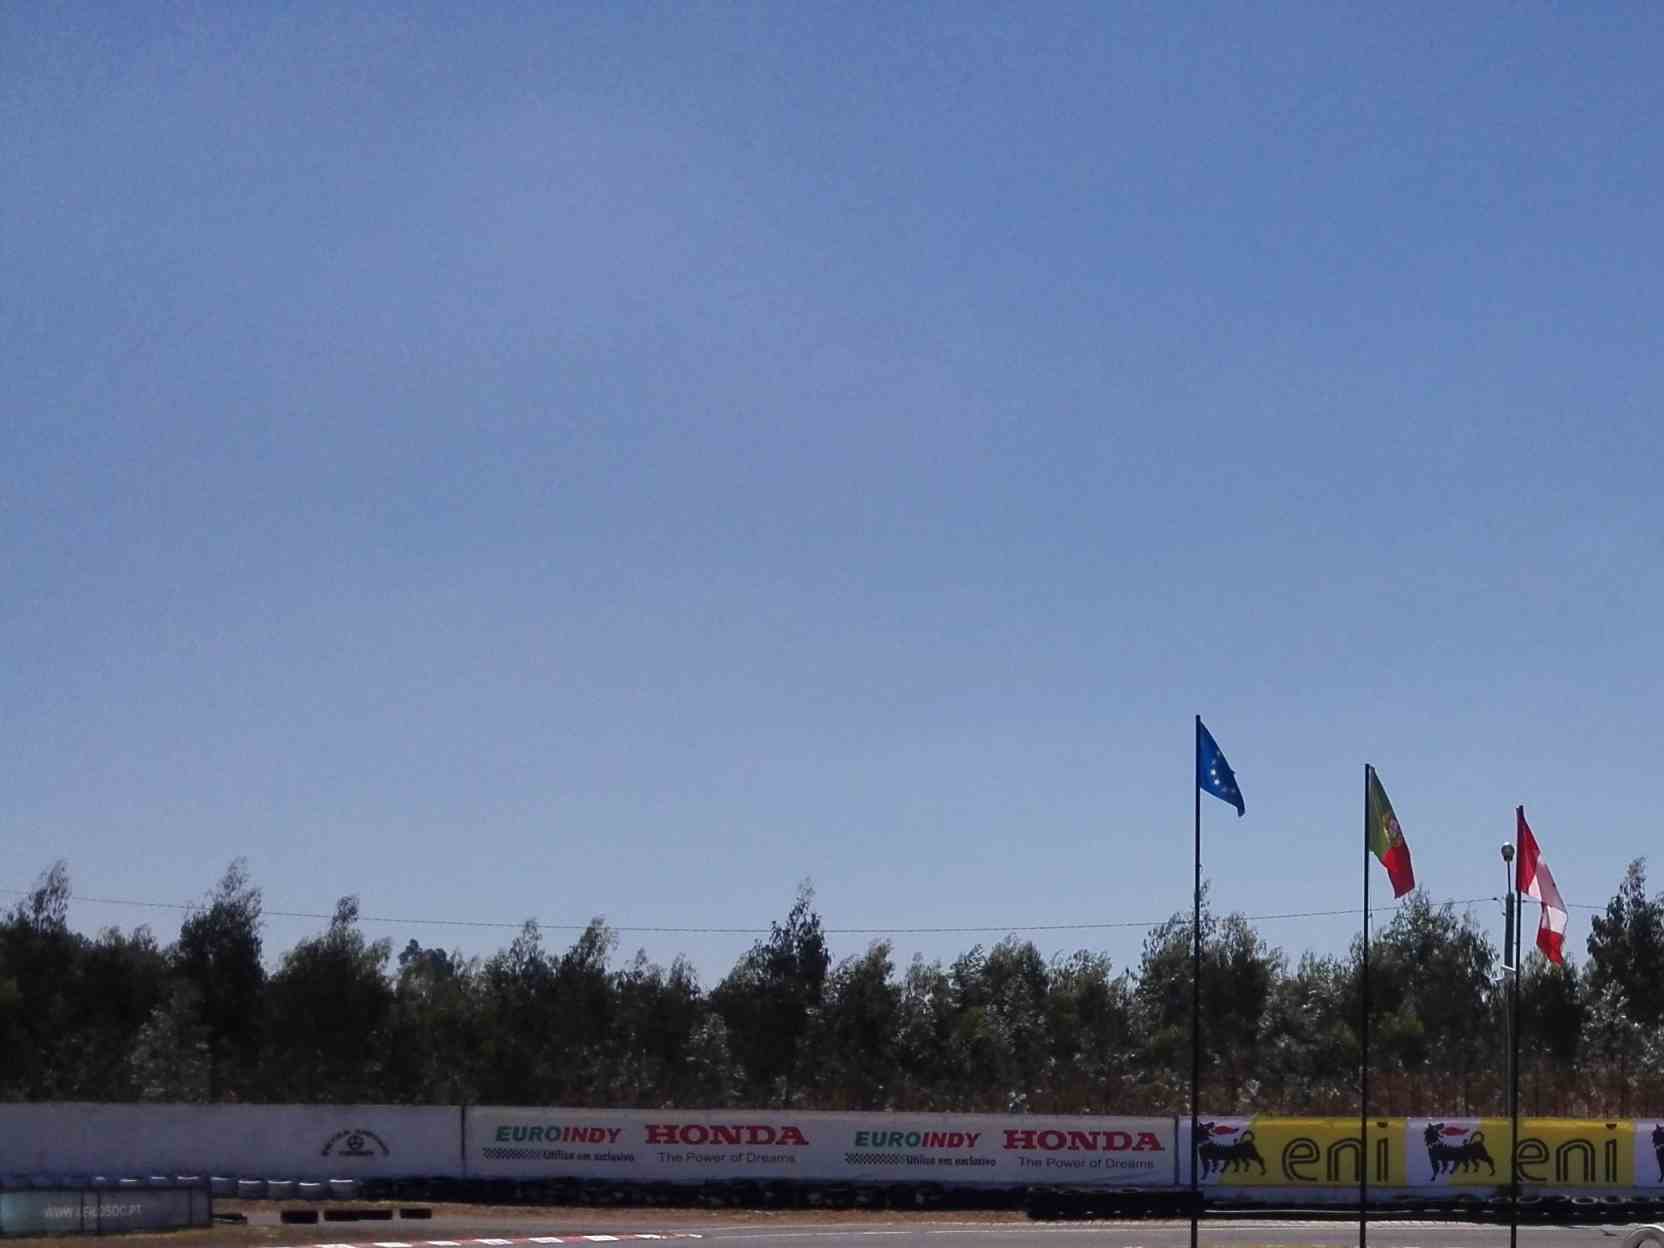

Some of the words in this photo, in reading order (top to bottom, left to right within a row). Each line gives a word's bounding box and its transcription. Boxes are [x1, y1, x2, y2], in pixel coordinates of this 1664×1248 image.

[495, 1125, 623, 1144] EUROINDY
[644, 1123, 810, 1146] HONDA
[854, 1130, 983, 1149] EUROINDY
[1001, 1128, 1165, 1151] HONDA
[659, 1151, 684, 1163] The
[686, 1152, 726, 1164] Power
[729, 1152, 743, 1163] of
[746, 1152, 797, 1164] Dreams
[1018, 1156, 1044, 1168] The
[1046, 1157, 1086, 1168] Power
[1089, 1157, 1103, 1168] of
[1105, 1157, 1155, 1169] Dreams
[1280, 1121, 1390, 1183] eni
[1515, 1122, 1619, 1184] eni
